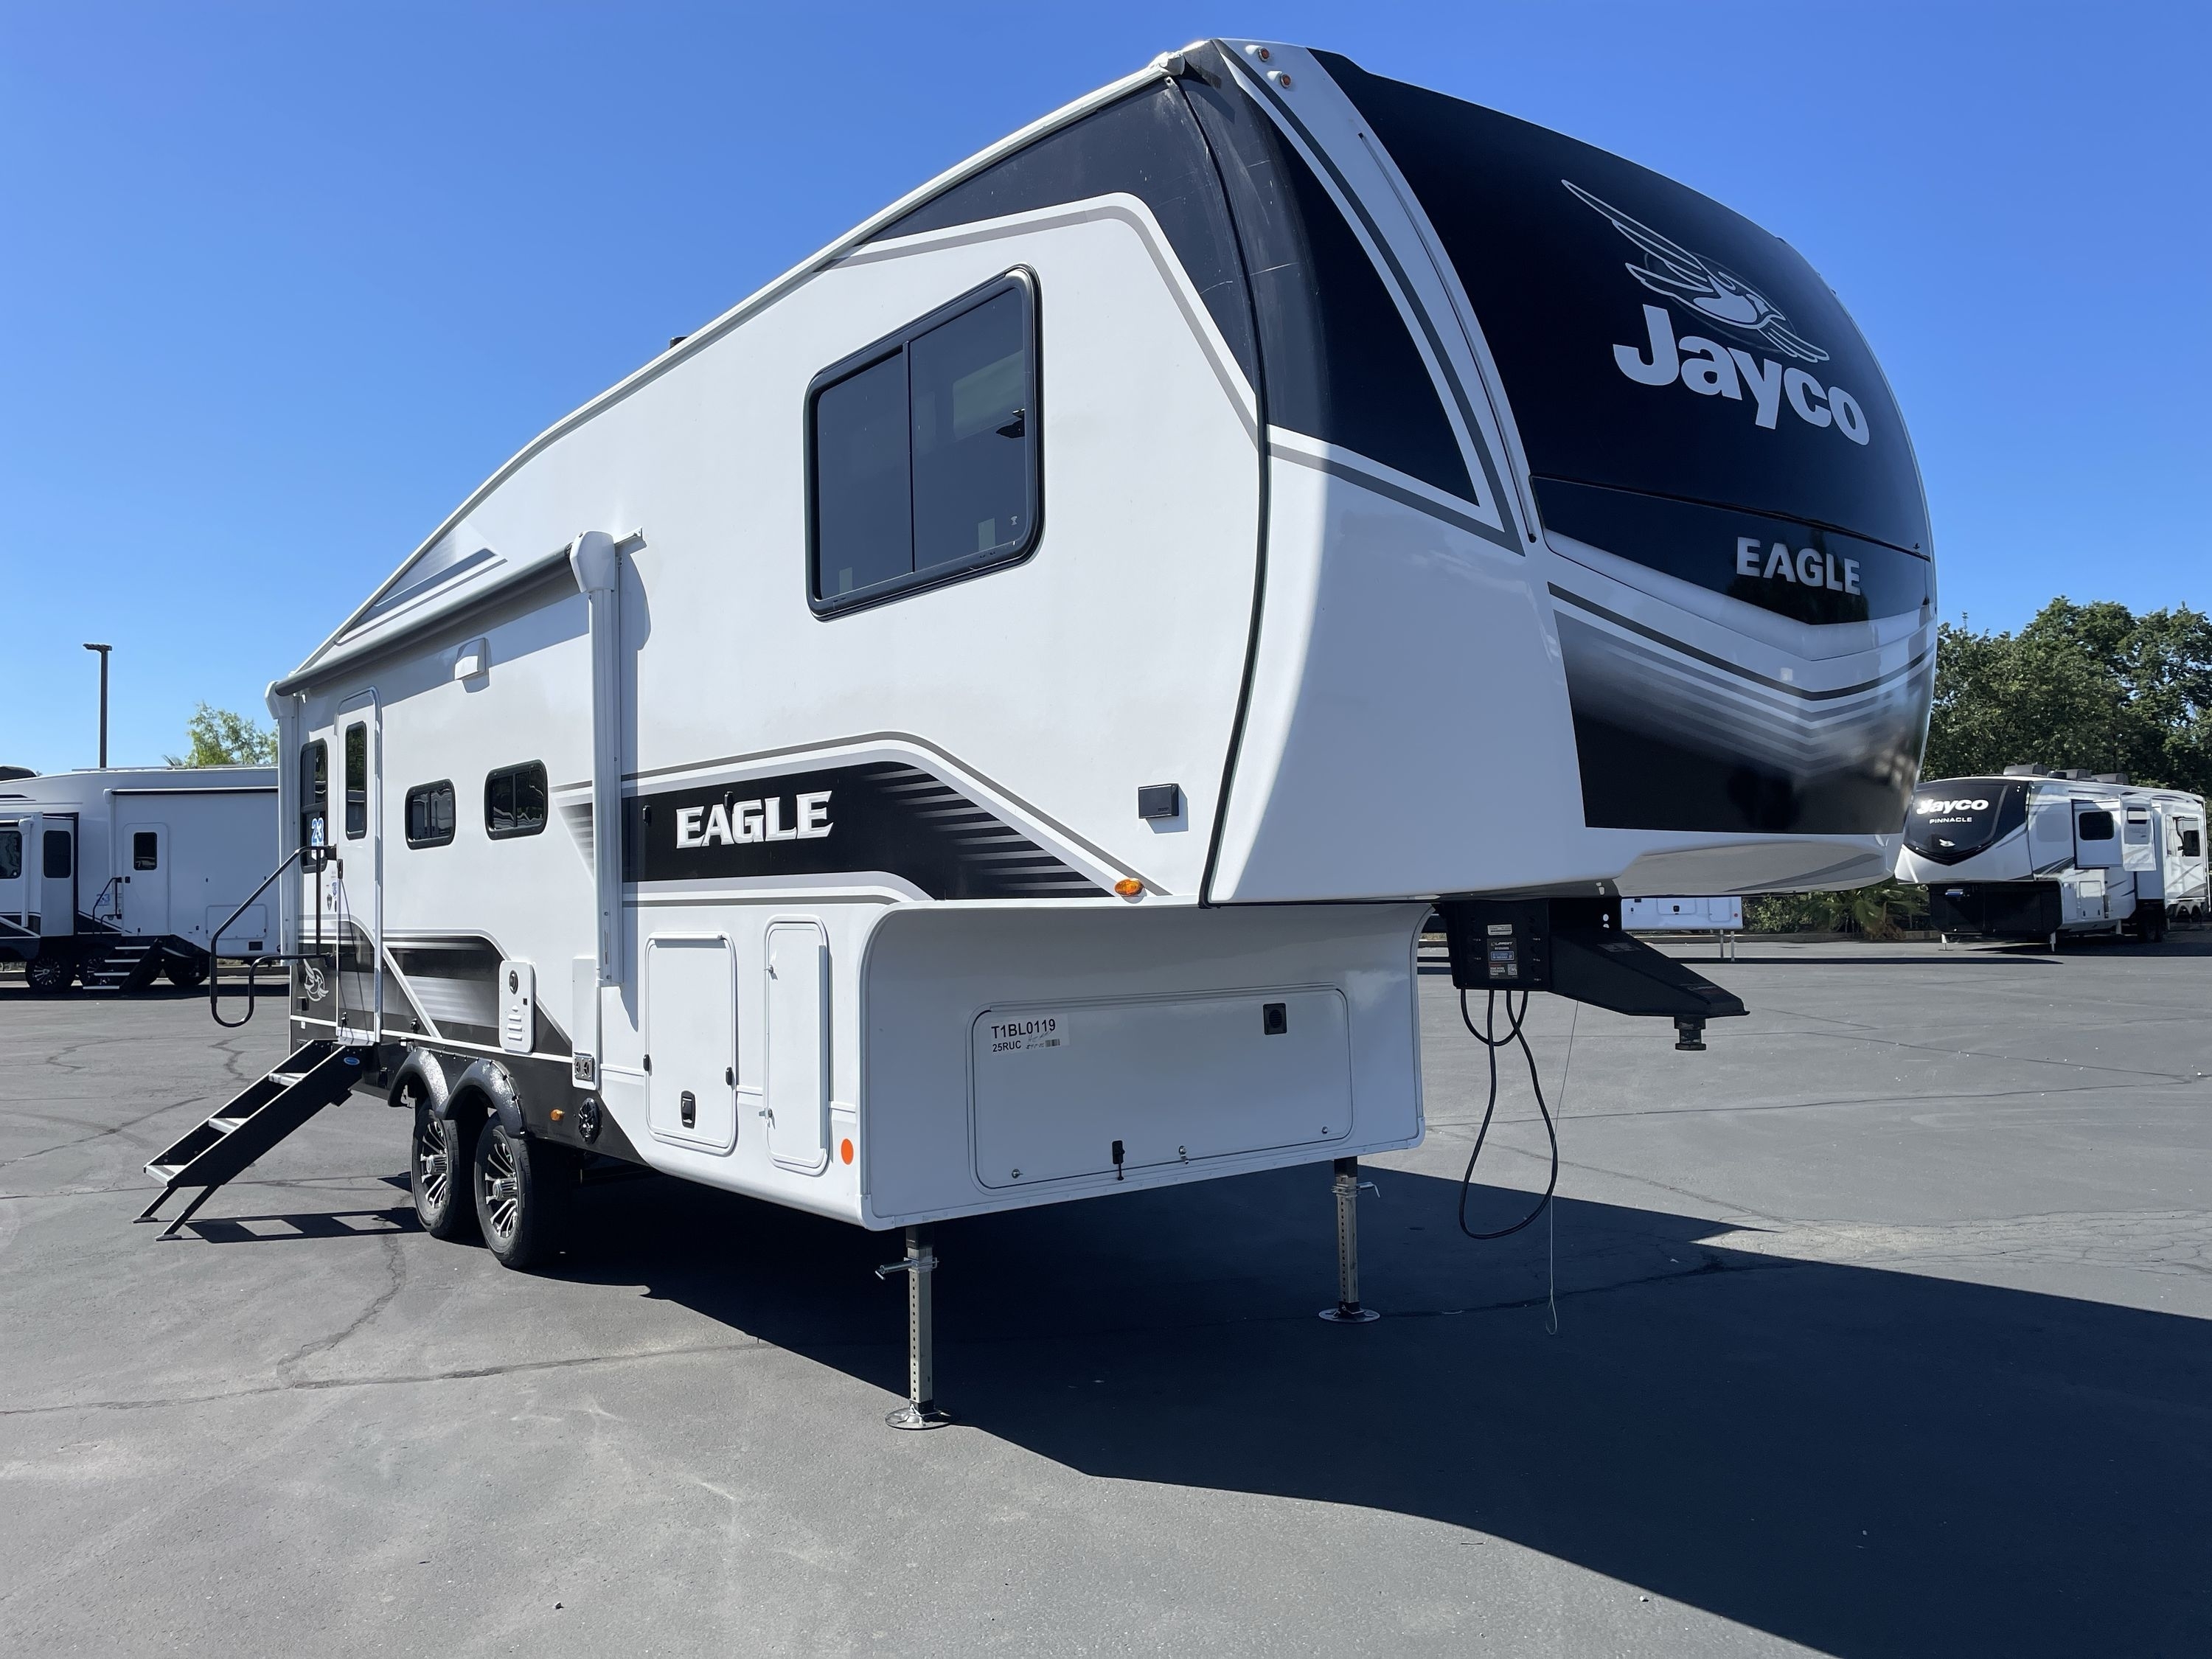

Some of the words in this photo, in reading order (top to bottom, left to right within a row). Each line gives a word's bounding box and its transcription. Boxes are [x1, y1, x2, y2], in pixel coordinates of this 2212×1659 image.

[1613, 304, 1870, 445] Jayco
[1736, 537, 1861, 596] EAGLE
[676, 790, 834, 849] EAGLE
[1916, 799, 1989, 814] Jayco
[991, 1018, 1056, 1039] T1BL0119
[992, 1040, 1022, 1052] 25RUC
